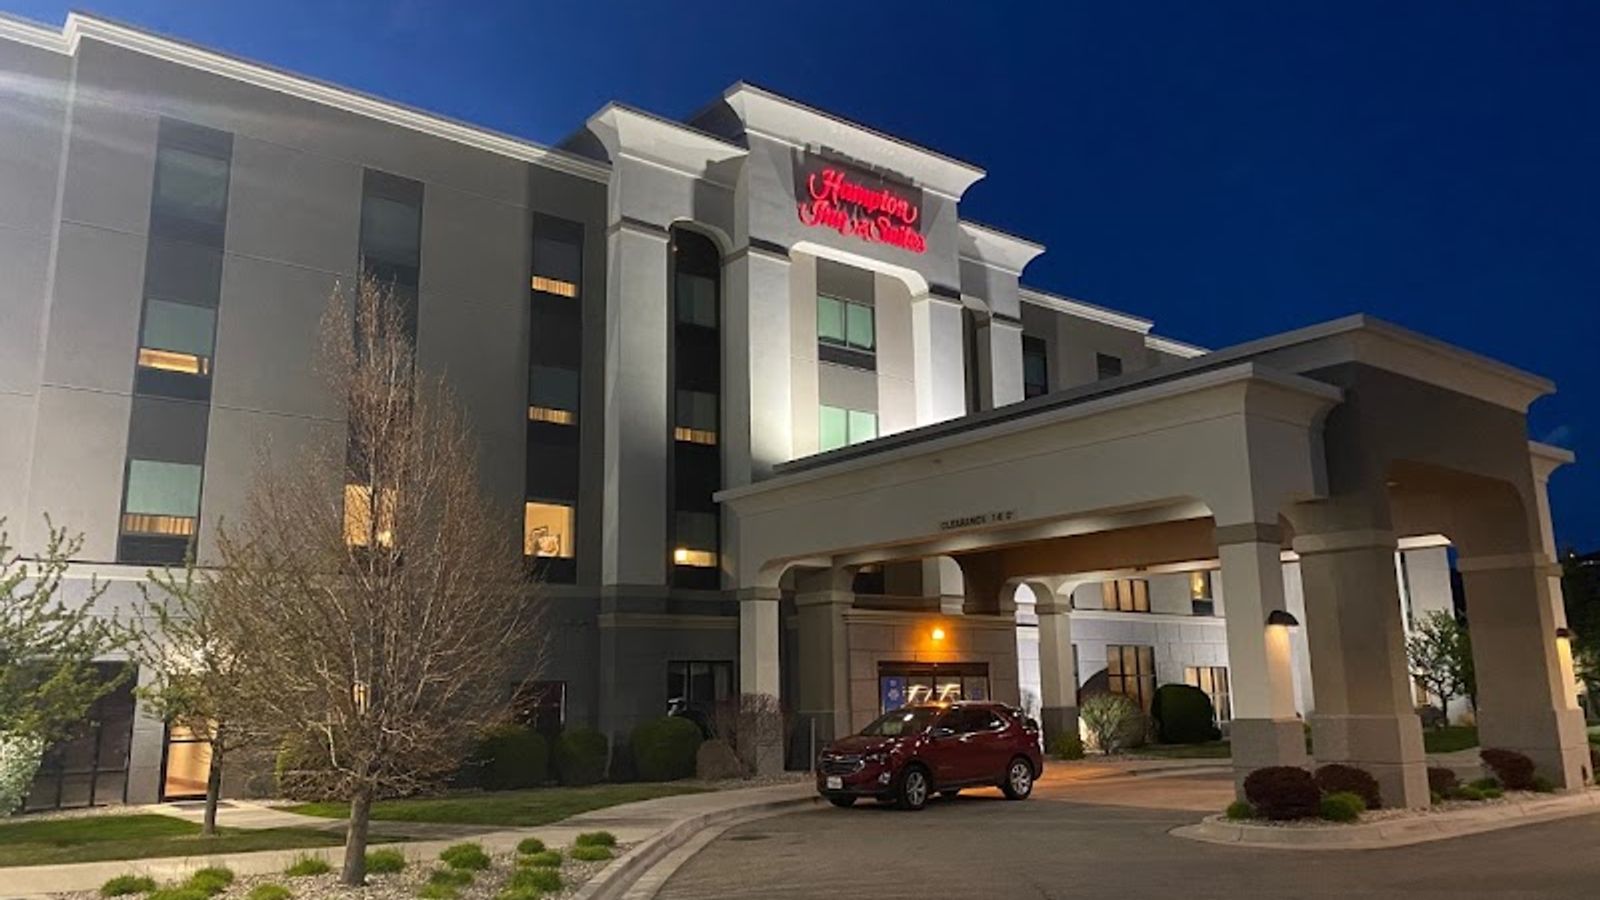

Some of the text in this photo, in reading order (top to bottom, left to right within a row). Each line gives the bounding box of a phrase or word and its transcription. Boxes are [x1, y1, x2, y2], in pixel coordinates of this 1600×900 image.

[809, 169, 918, 224] Hampton
[800, 200, 855, 236] Inn
[870, 215, 928, 255] Suites
